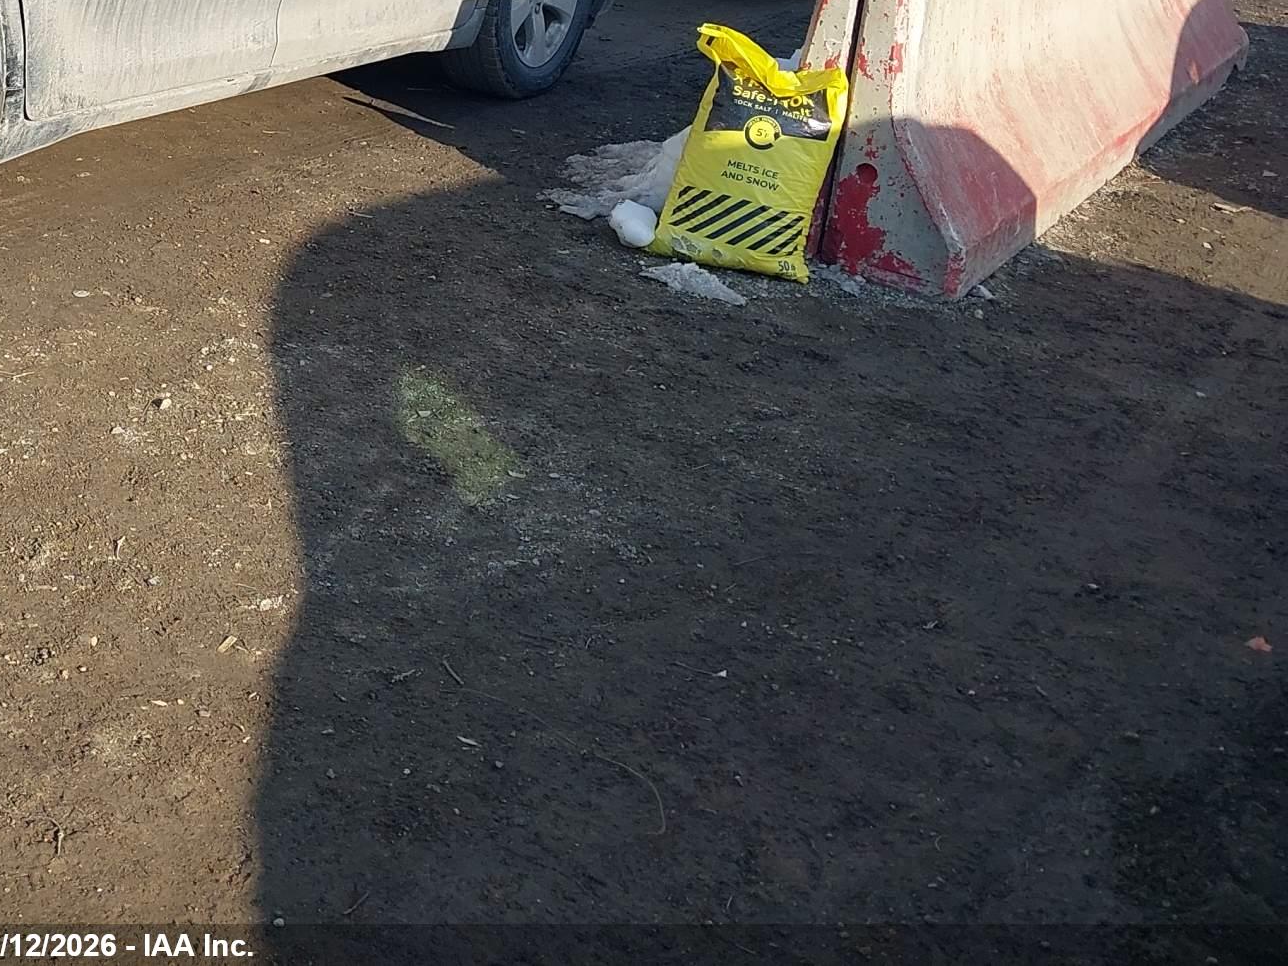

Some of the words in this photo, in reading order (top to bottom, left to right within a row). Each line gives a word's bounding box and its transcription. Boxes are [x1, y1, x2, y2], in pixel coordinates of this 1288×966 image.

[728, 159, 759, 174] MELTS
[762, 168, 779, 179] ICE
[721, 170, 743, 181] AND
[746, 176, 779, 191] SNOW
[778, 260, 790, 272] 50
